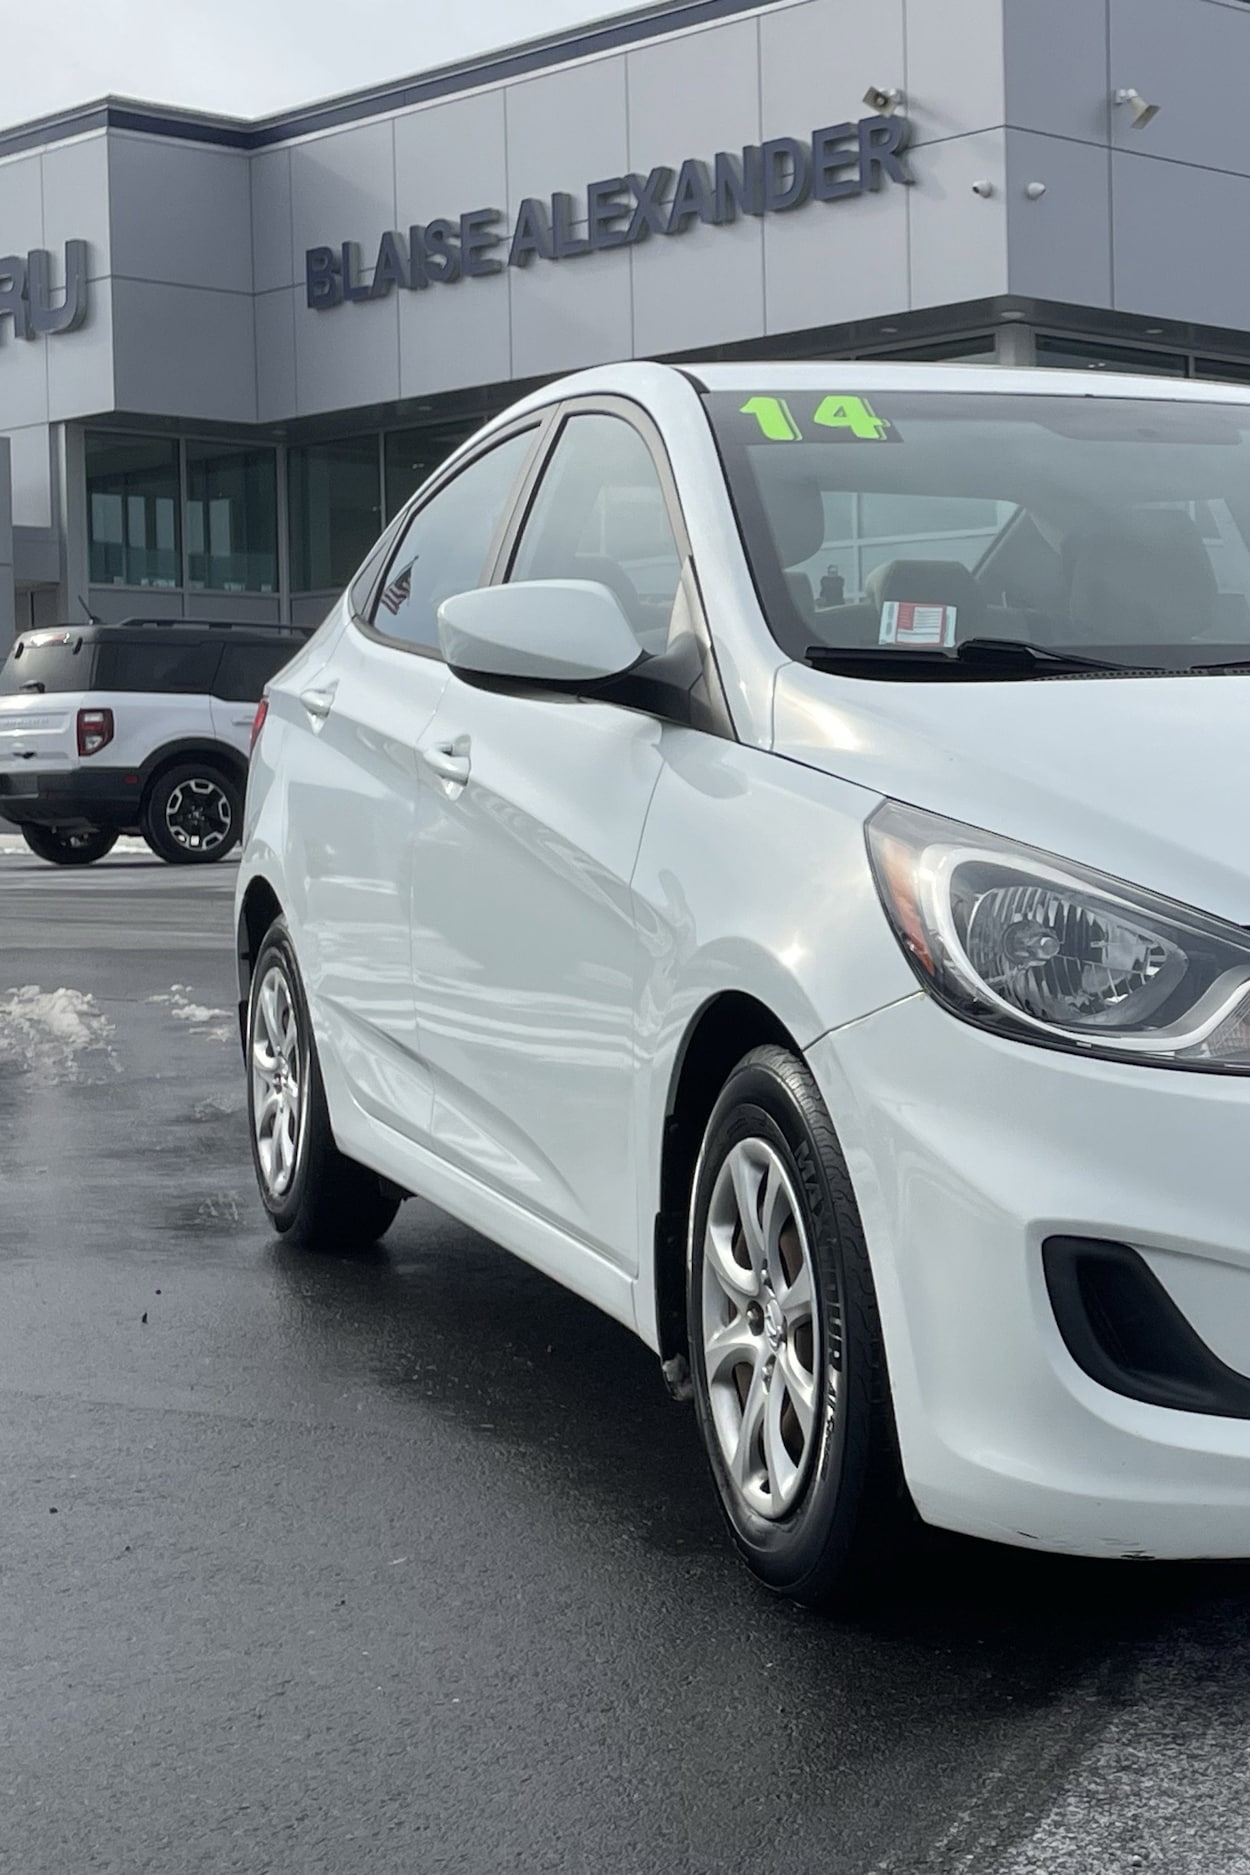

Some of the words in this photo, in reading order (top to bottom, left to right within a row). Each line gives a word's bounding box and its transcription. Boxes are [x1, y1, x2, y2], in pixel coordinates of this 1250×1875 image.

[306, 208, 504, 308] BLAISE
[508, 114, 915, 267] ALEXANDER
[739, 395, 890, 440] 14
